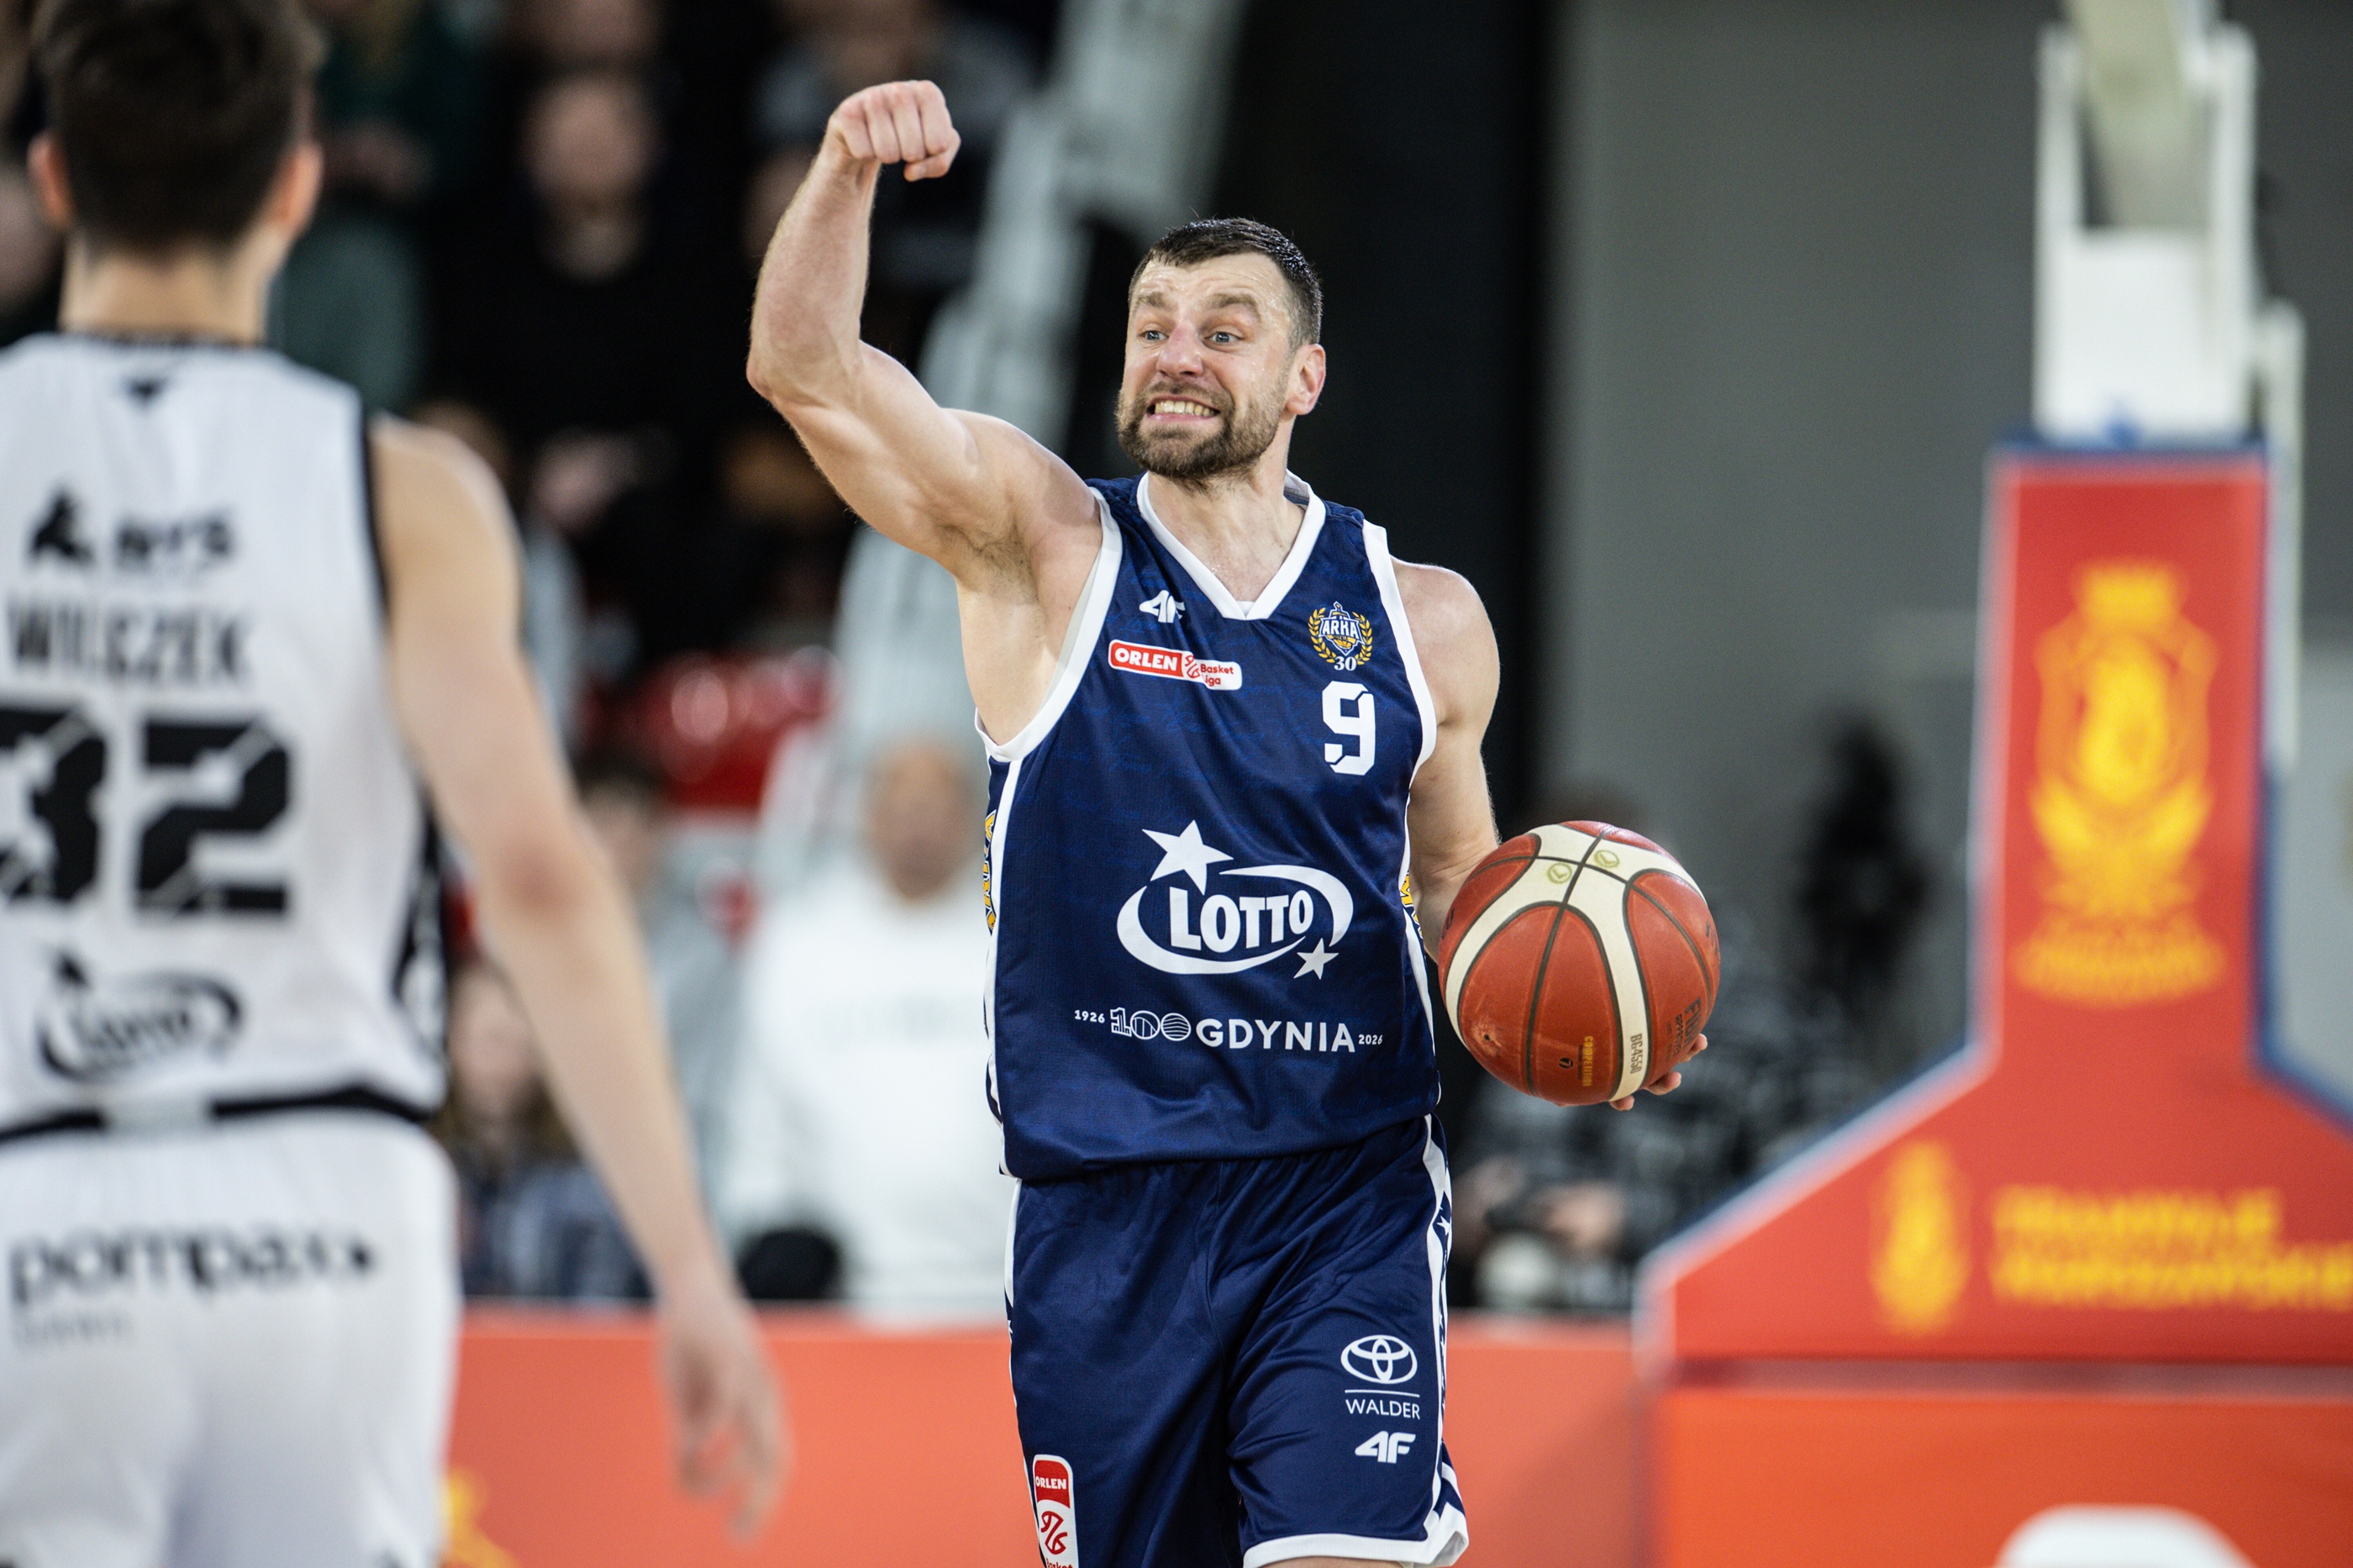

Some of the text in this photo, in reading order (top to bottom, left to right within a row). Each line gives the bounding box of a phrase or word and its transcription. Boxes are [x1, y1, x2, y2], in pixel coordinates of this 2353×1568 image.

[1115, 647, 1178, 671] ORLEN
[1200, 664, 1234, 675] Basket
[1334, 655, 1357, 671] 30
[1322, 681, 1377, 776] 9
[1169, 886, 1314, 954] LOTTO
[1074, 1007, 1384, 1053] 1926 100 GDYNIA 2026
[1629, 1033, 1644, 1075] BG4550
[1345, 1399, 1421, 1420] WALDER
[1355, 1430, 1417, 1464] 4F
[1035, 1476, 1067, 1490] ORLEN
